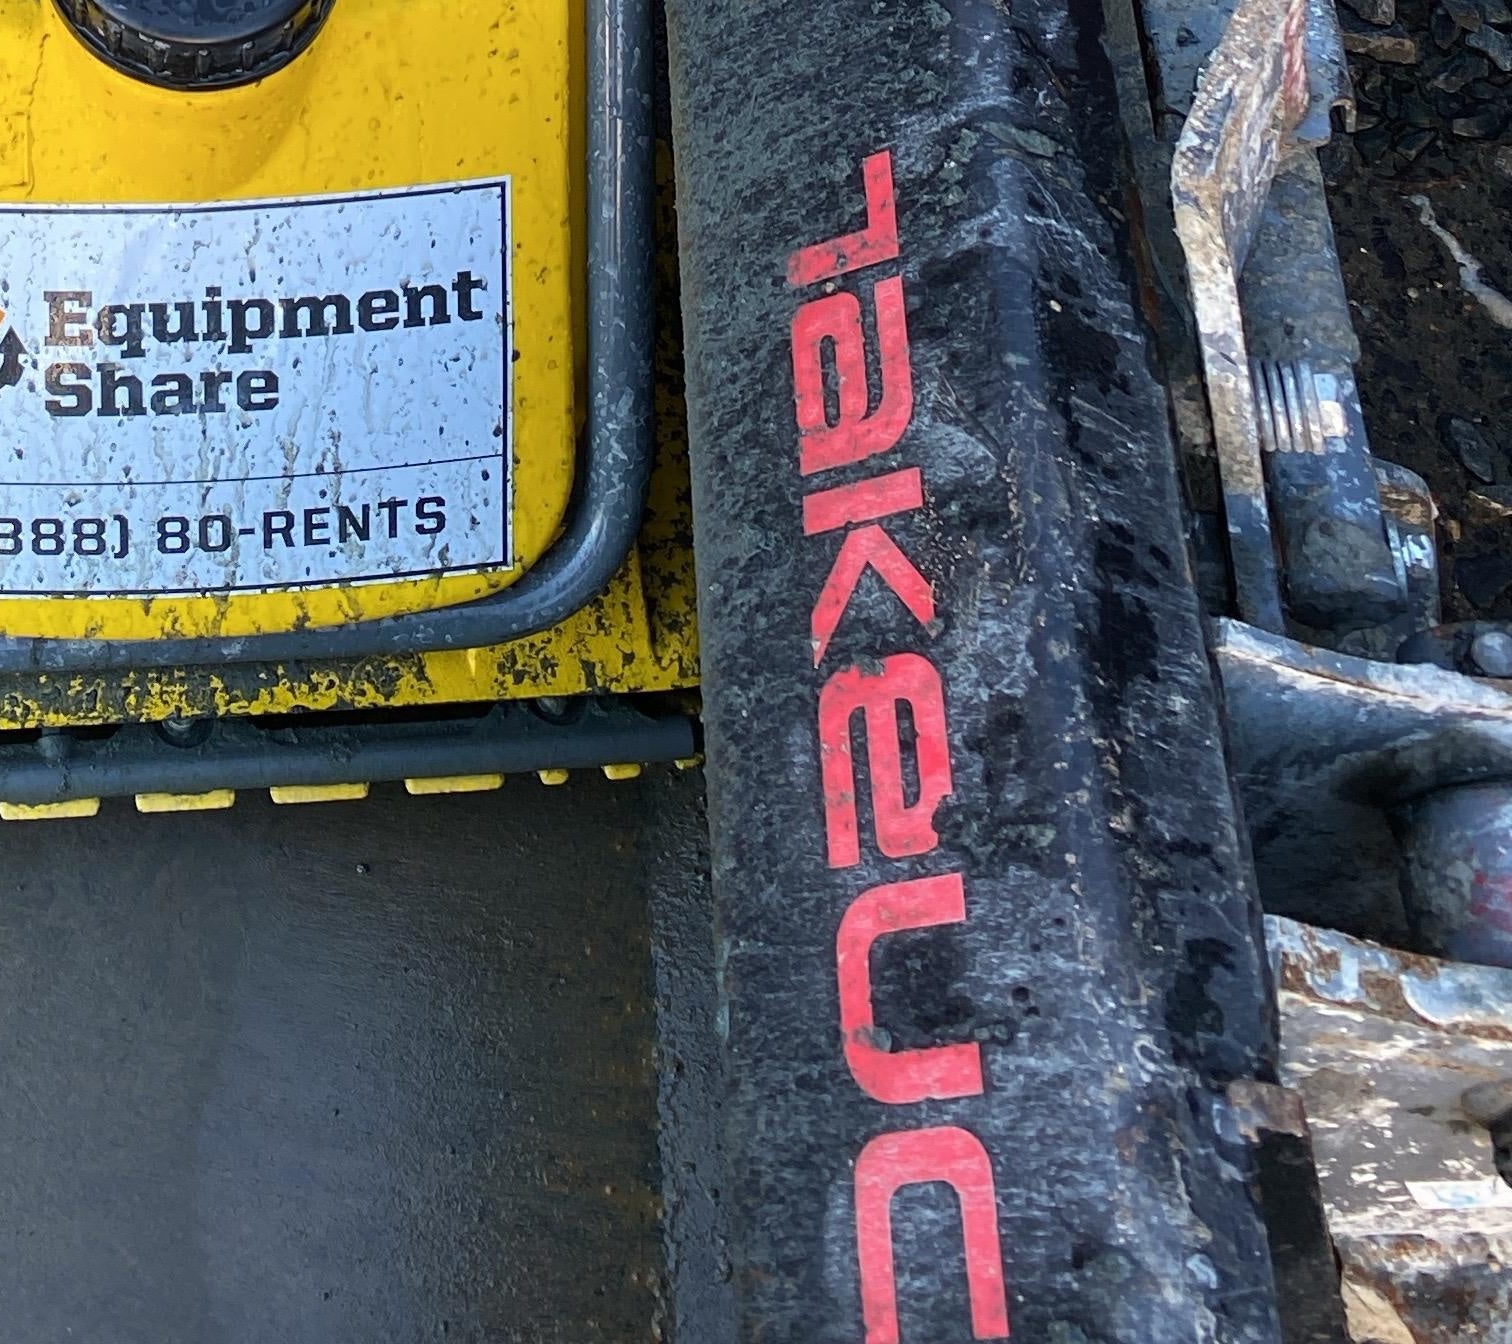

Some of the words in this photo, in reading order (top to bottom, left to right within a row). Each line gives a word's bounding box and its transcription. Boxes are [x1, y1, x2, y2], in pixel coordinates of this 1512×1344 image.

[42, 269, 489, 360] Equipment
[43, 361, 281, 418] Share
[156, 494, 448, 555] 80-RENTS
